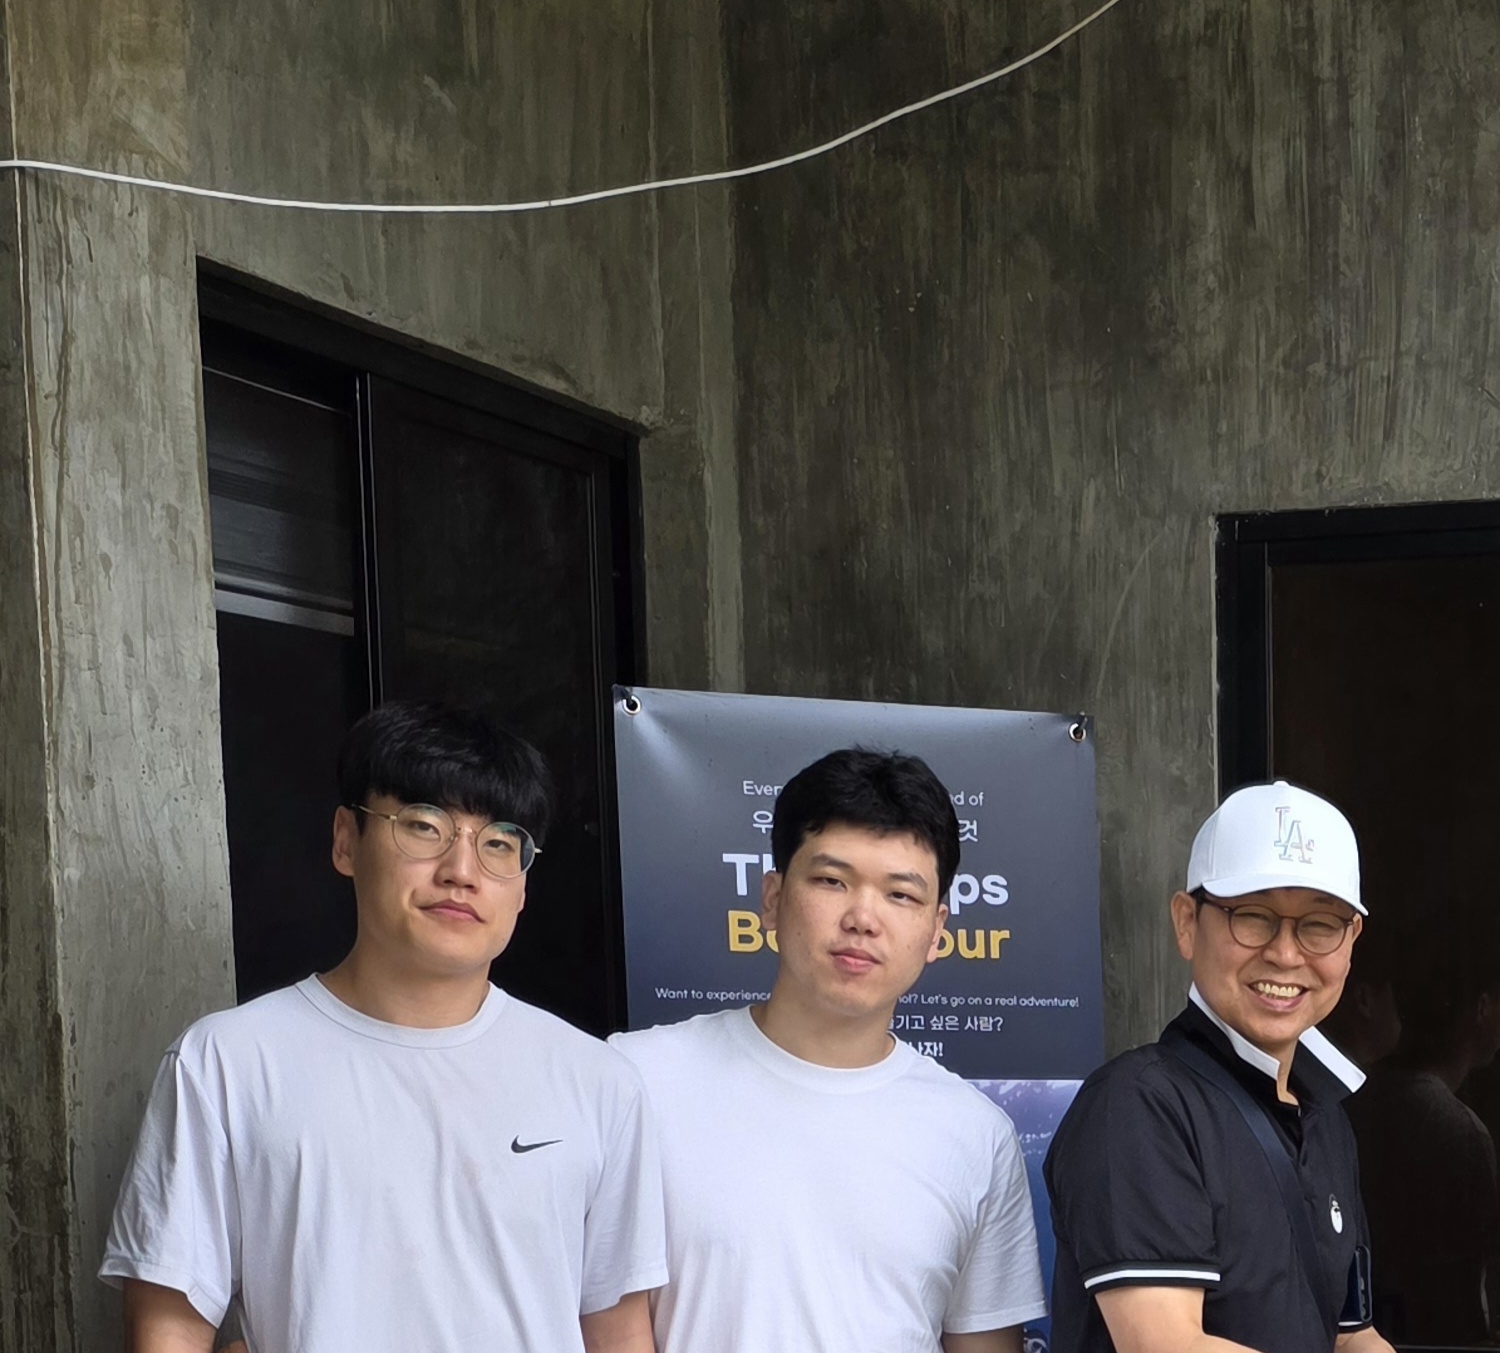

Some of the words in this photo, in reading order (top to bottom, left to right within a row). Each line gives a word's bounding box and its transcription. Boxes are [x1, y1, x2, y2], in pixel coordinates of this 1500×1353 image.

[743, 780, 784, 796] Ever
[968, 791, 984, 807] of
[1274, 806, 1315, 865] LA
[949, 873, 1009, 915] ps
[936, 928, 1010, 959] our
[655, 987, 688, 999] Want
[691, 989, 703, 1000] to
[921, 993, 948, 1005] Let's
[950, 996, 966, 1008] go
[967, 996, 982, 1006] on
[984, 997, 993, 1006] a
[995, 995, 1017, 1006] real
[1019, 996, 1079, 1008] adventure!
[930, 1015, 960, 1031] 싶은
[964, 1015, 1004, 1032] 사람?
